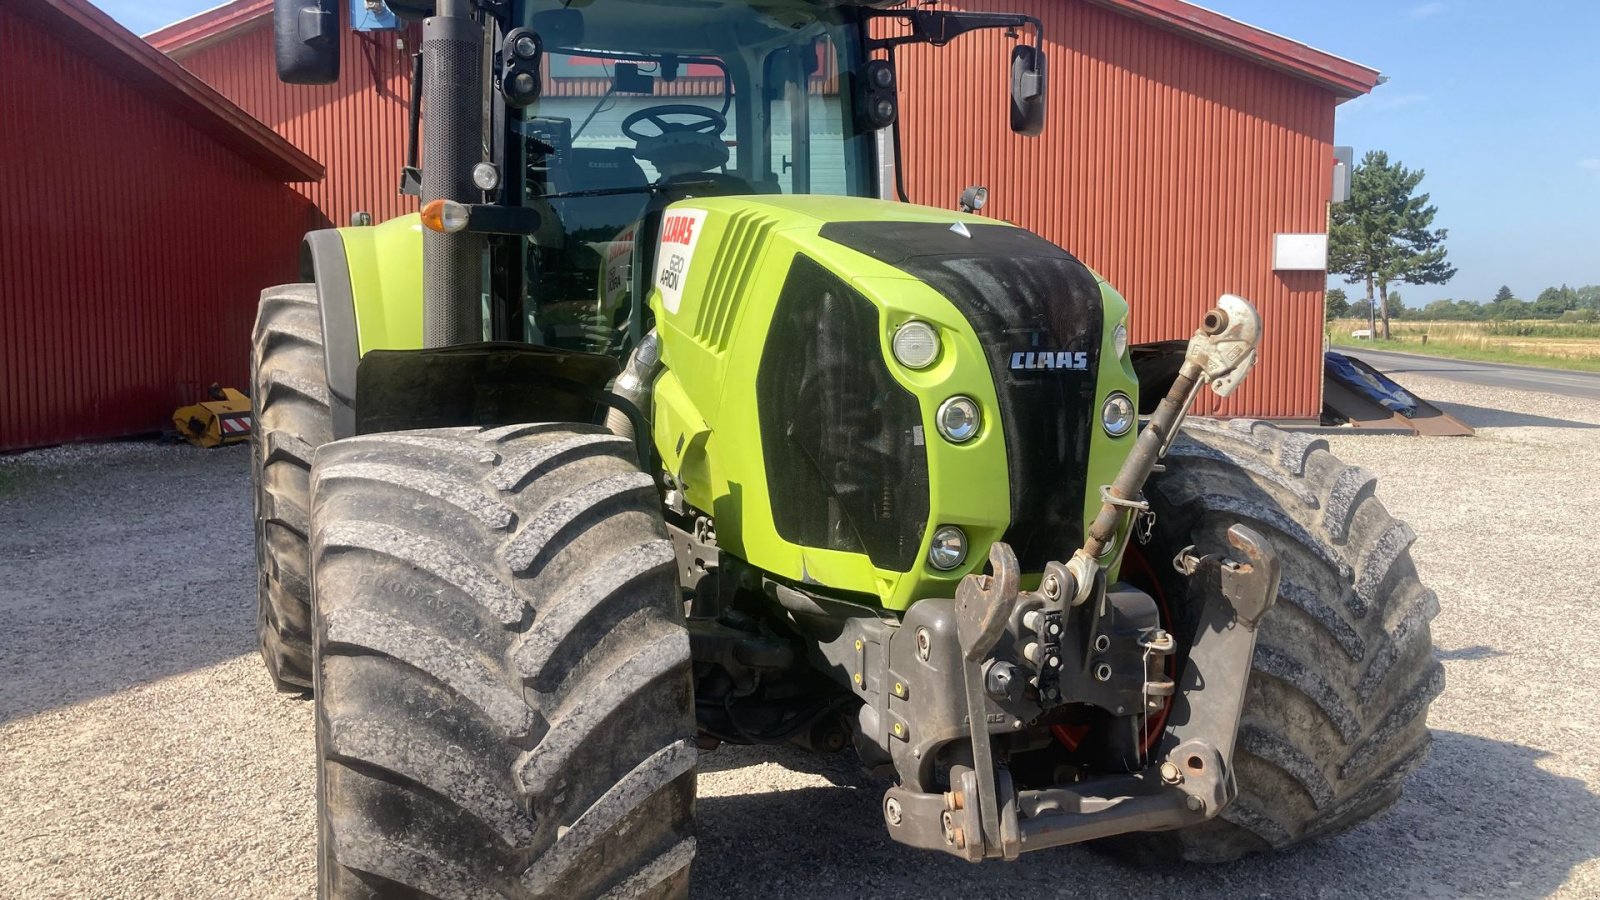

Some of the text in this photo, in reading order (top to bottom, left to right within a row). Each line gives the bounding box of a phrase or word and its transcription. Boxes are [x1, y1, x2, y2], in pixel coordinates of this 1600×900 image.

[661, 216, 695, 245] CLAAS
[670, 254, 685, 274] 620
[660, 268, 680, 291] ARION
[1011, 351, 1088, 370] CLAAS
